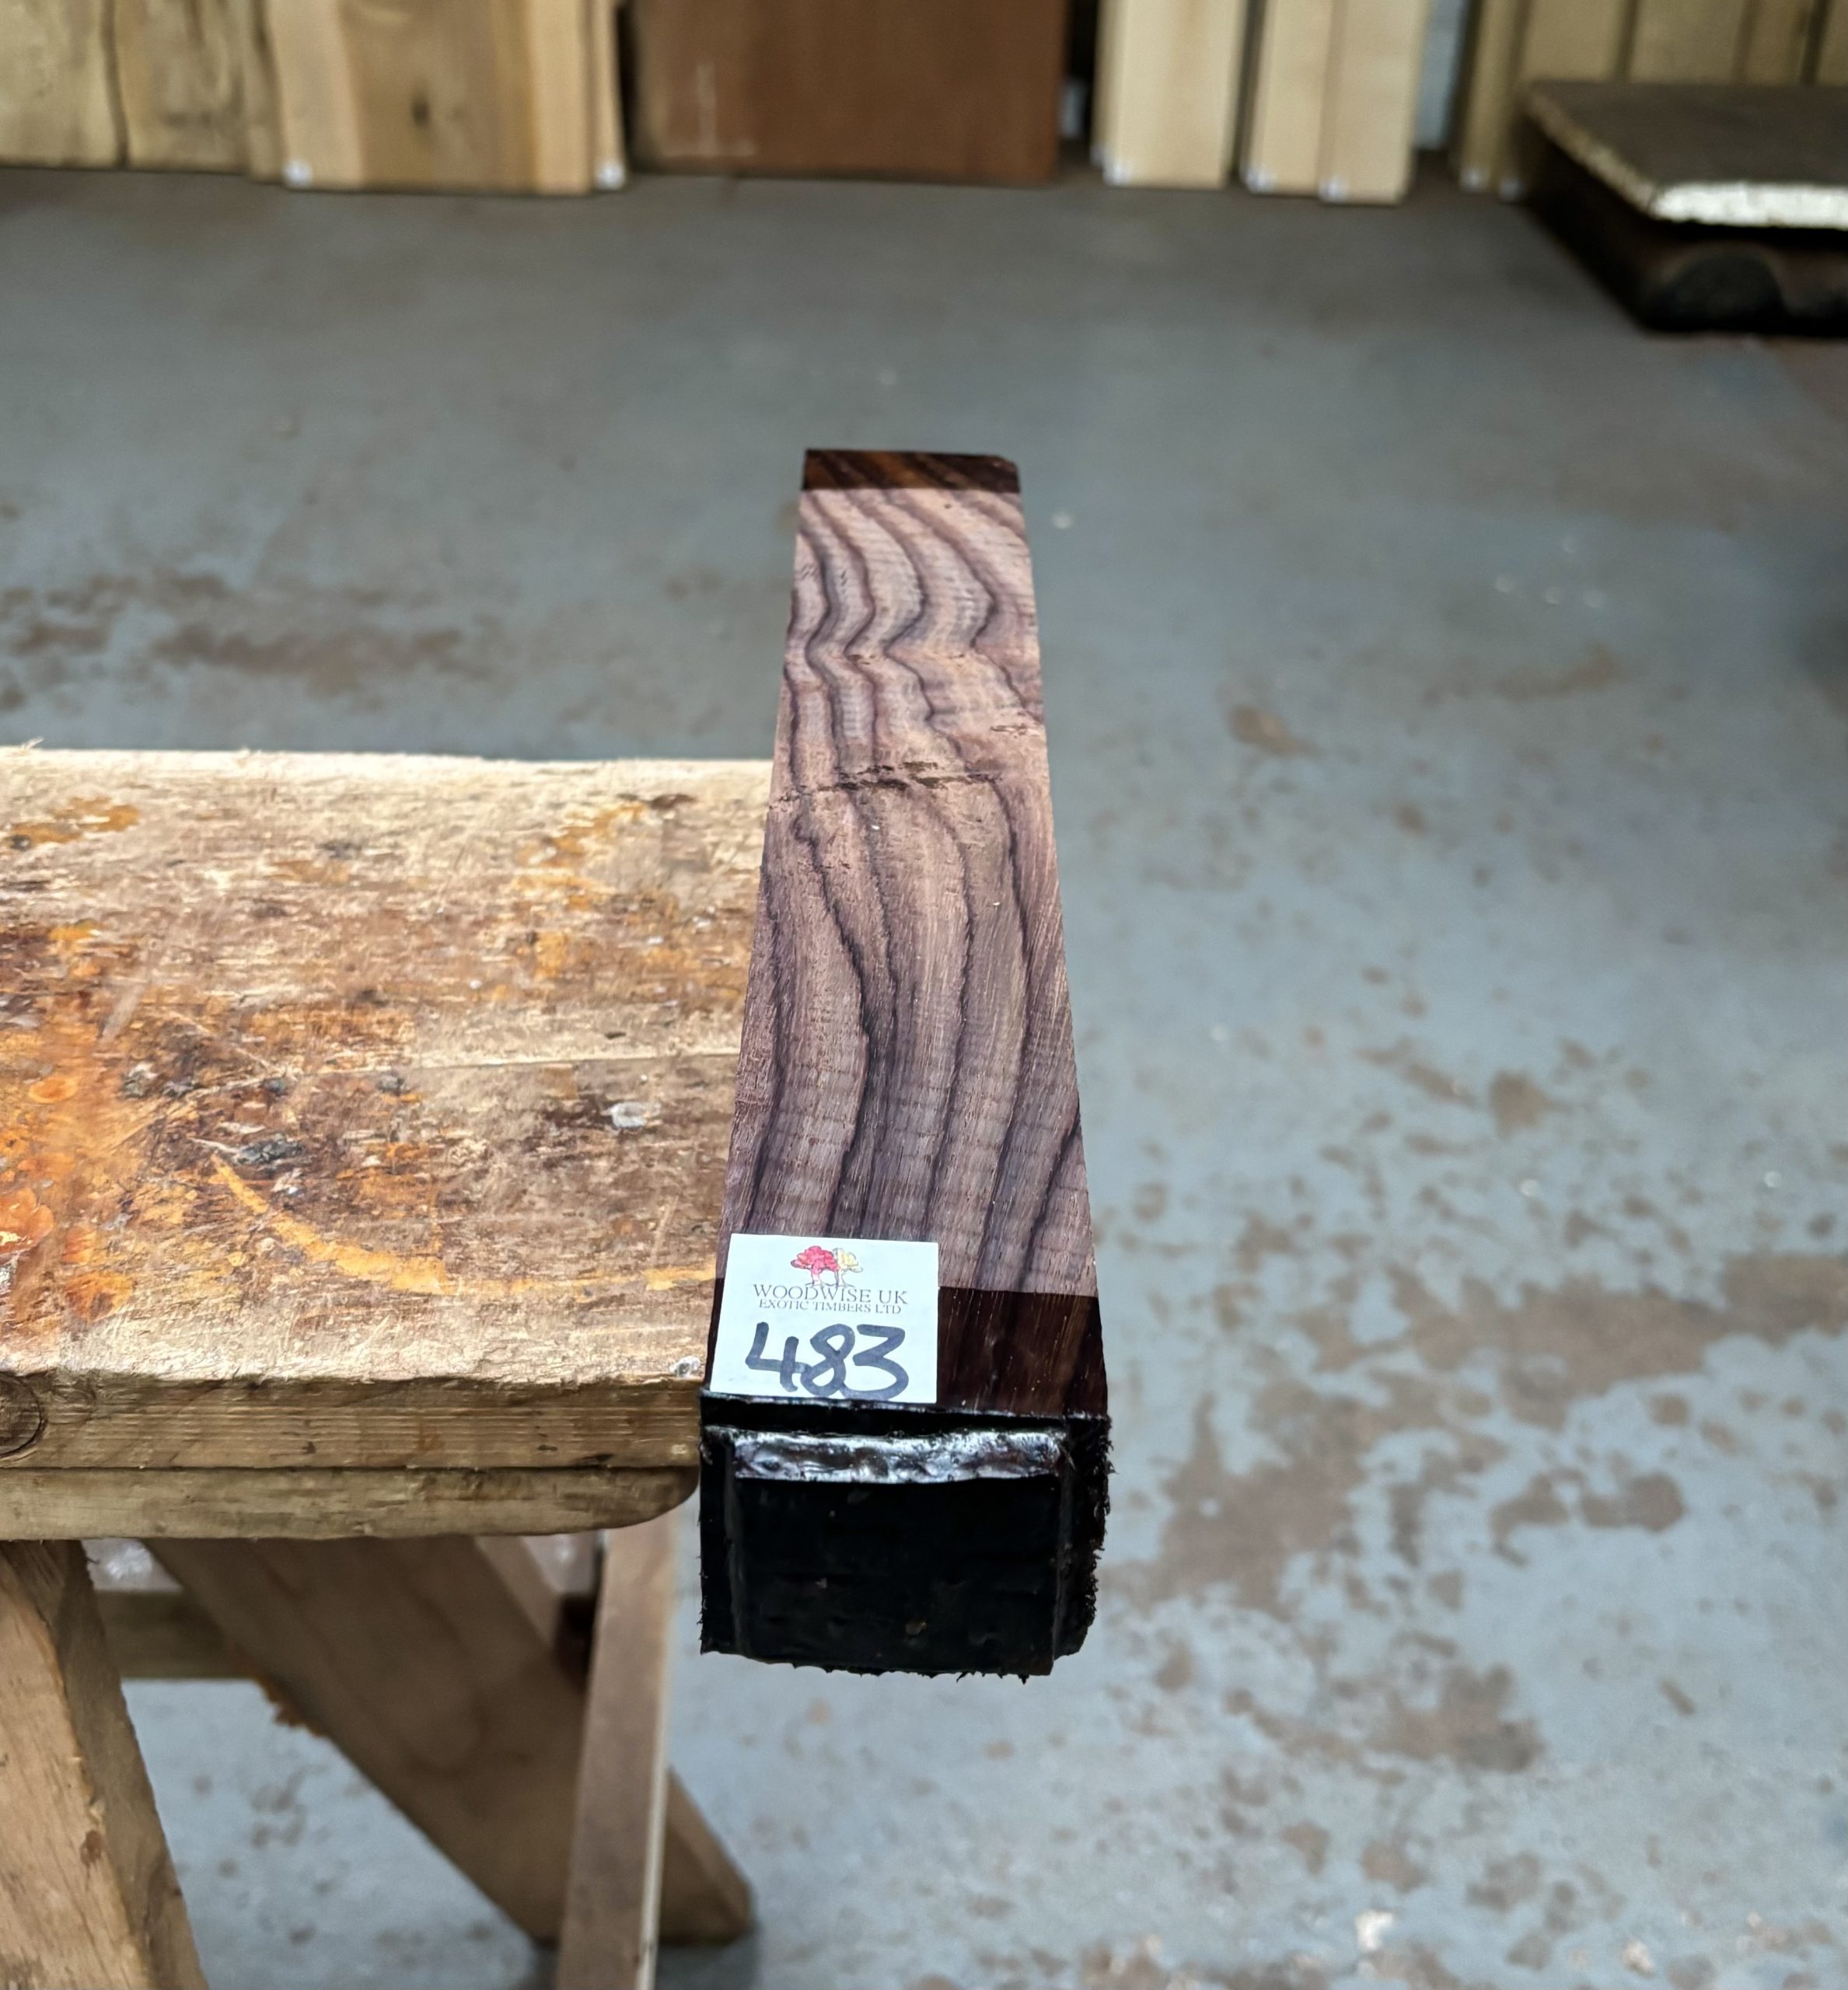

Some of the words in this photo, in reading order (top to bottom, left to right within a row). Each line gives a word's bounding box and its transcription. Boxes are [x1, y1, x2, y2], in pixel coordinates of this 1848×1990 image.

[753, 1283, 872, 1303] WOODWISE
[879, 1290, 908, 1304] UK
[759, 1299, 809, 1311] EXOTIC
[814, 1301, 872, 1313] TIMBERS
[875, 1304, 902, 1314] LTD
[745, 1321, 910, 1400] 483
